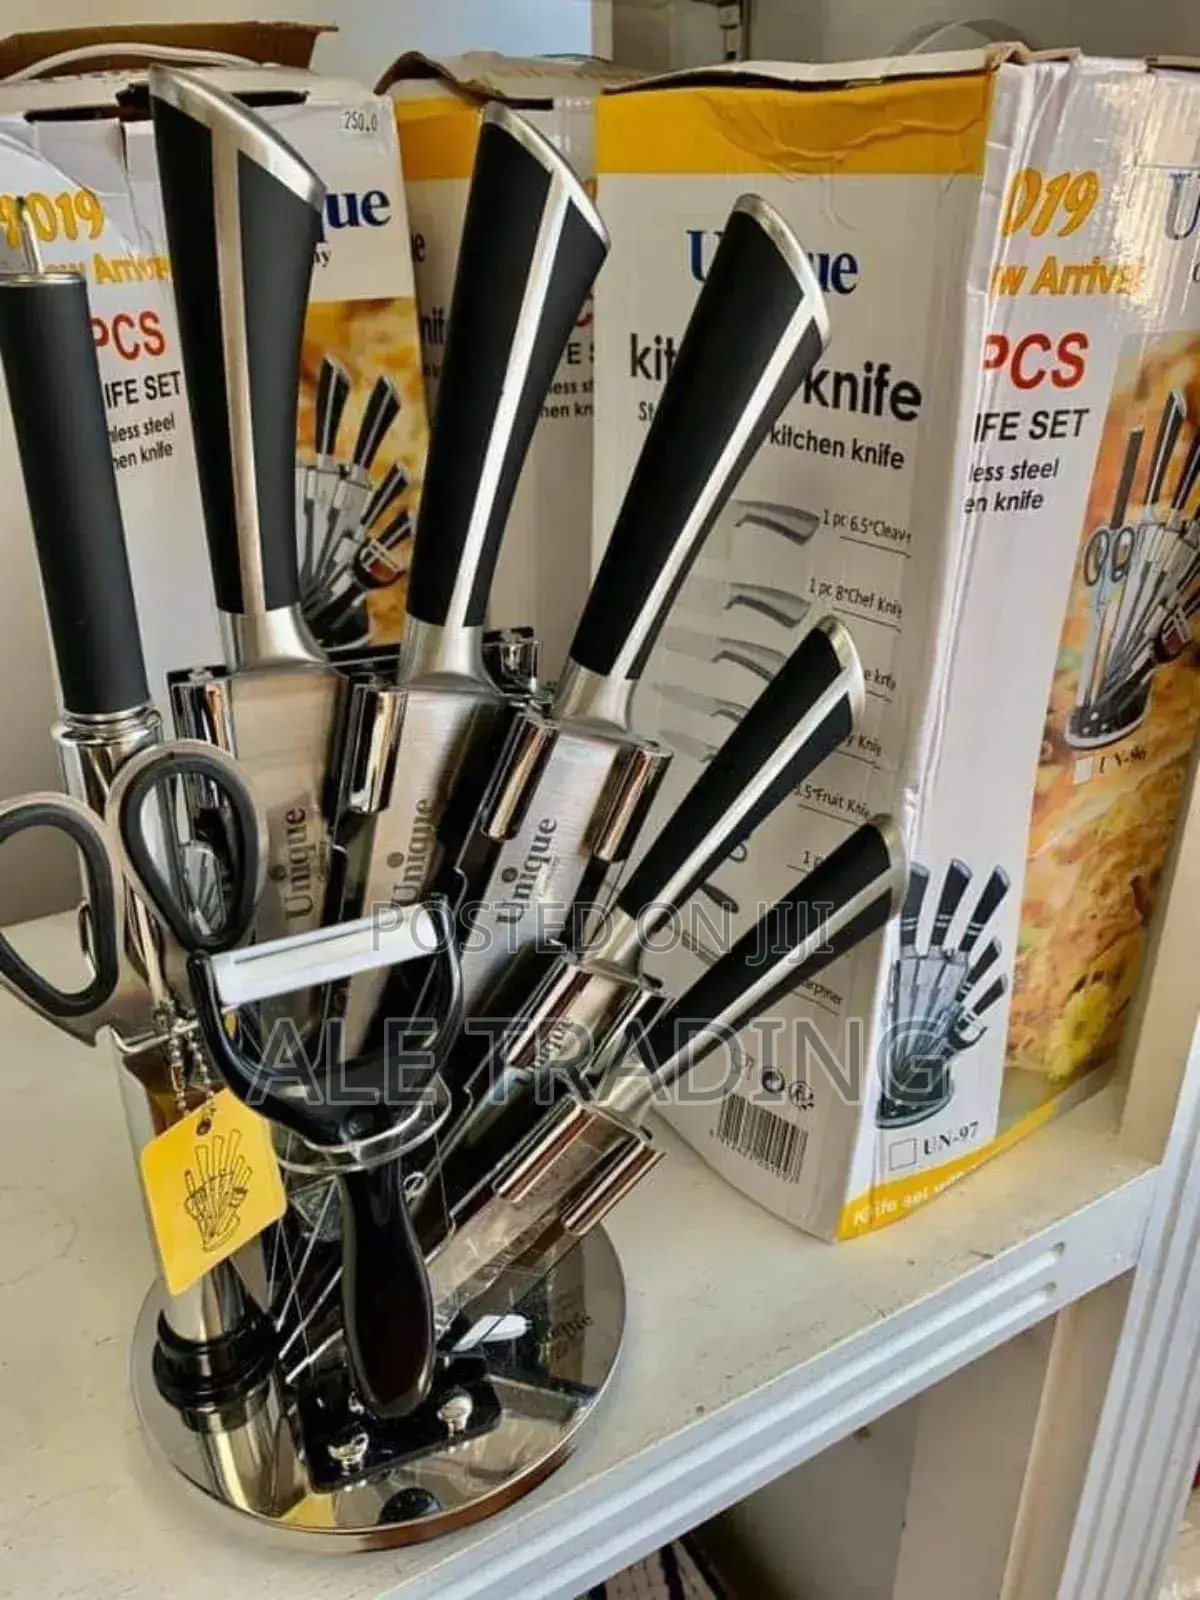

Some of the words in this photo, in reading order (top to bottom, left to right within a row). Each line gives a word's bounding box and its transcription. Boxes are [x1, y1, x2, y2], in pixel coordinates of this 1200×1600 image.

[343, 110, 379, 132] 250.0
[104, 378, 140, 410] IFE
[143, 370, 181, 401] SET
[802, 360, 922, 422] knife
[143, 412, 176, 437] steel
[973, 410, 1022, 443] IFE
[1028, 408, 1090, 441] SET
[140, 440, 174, 465] knife
[769, 425, 845, 460] kitchen
[851, 438, 905, 470] knife
[1010, 456, 1060, 481] steel
[994, 488, 1045, 513] knife
[267, 806, 318, 920] Unique
[496, 818, 558, 926] Unique
